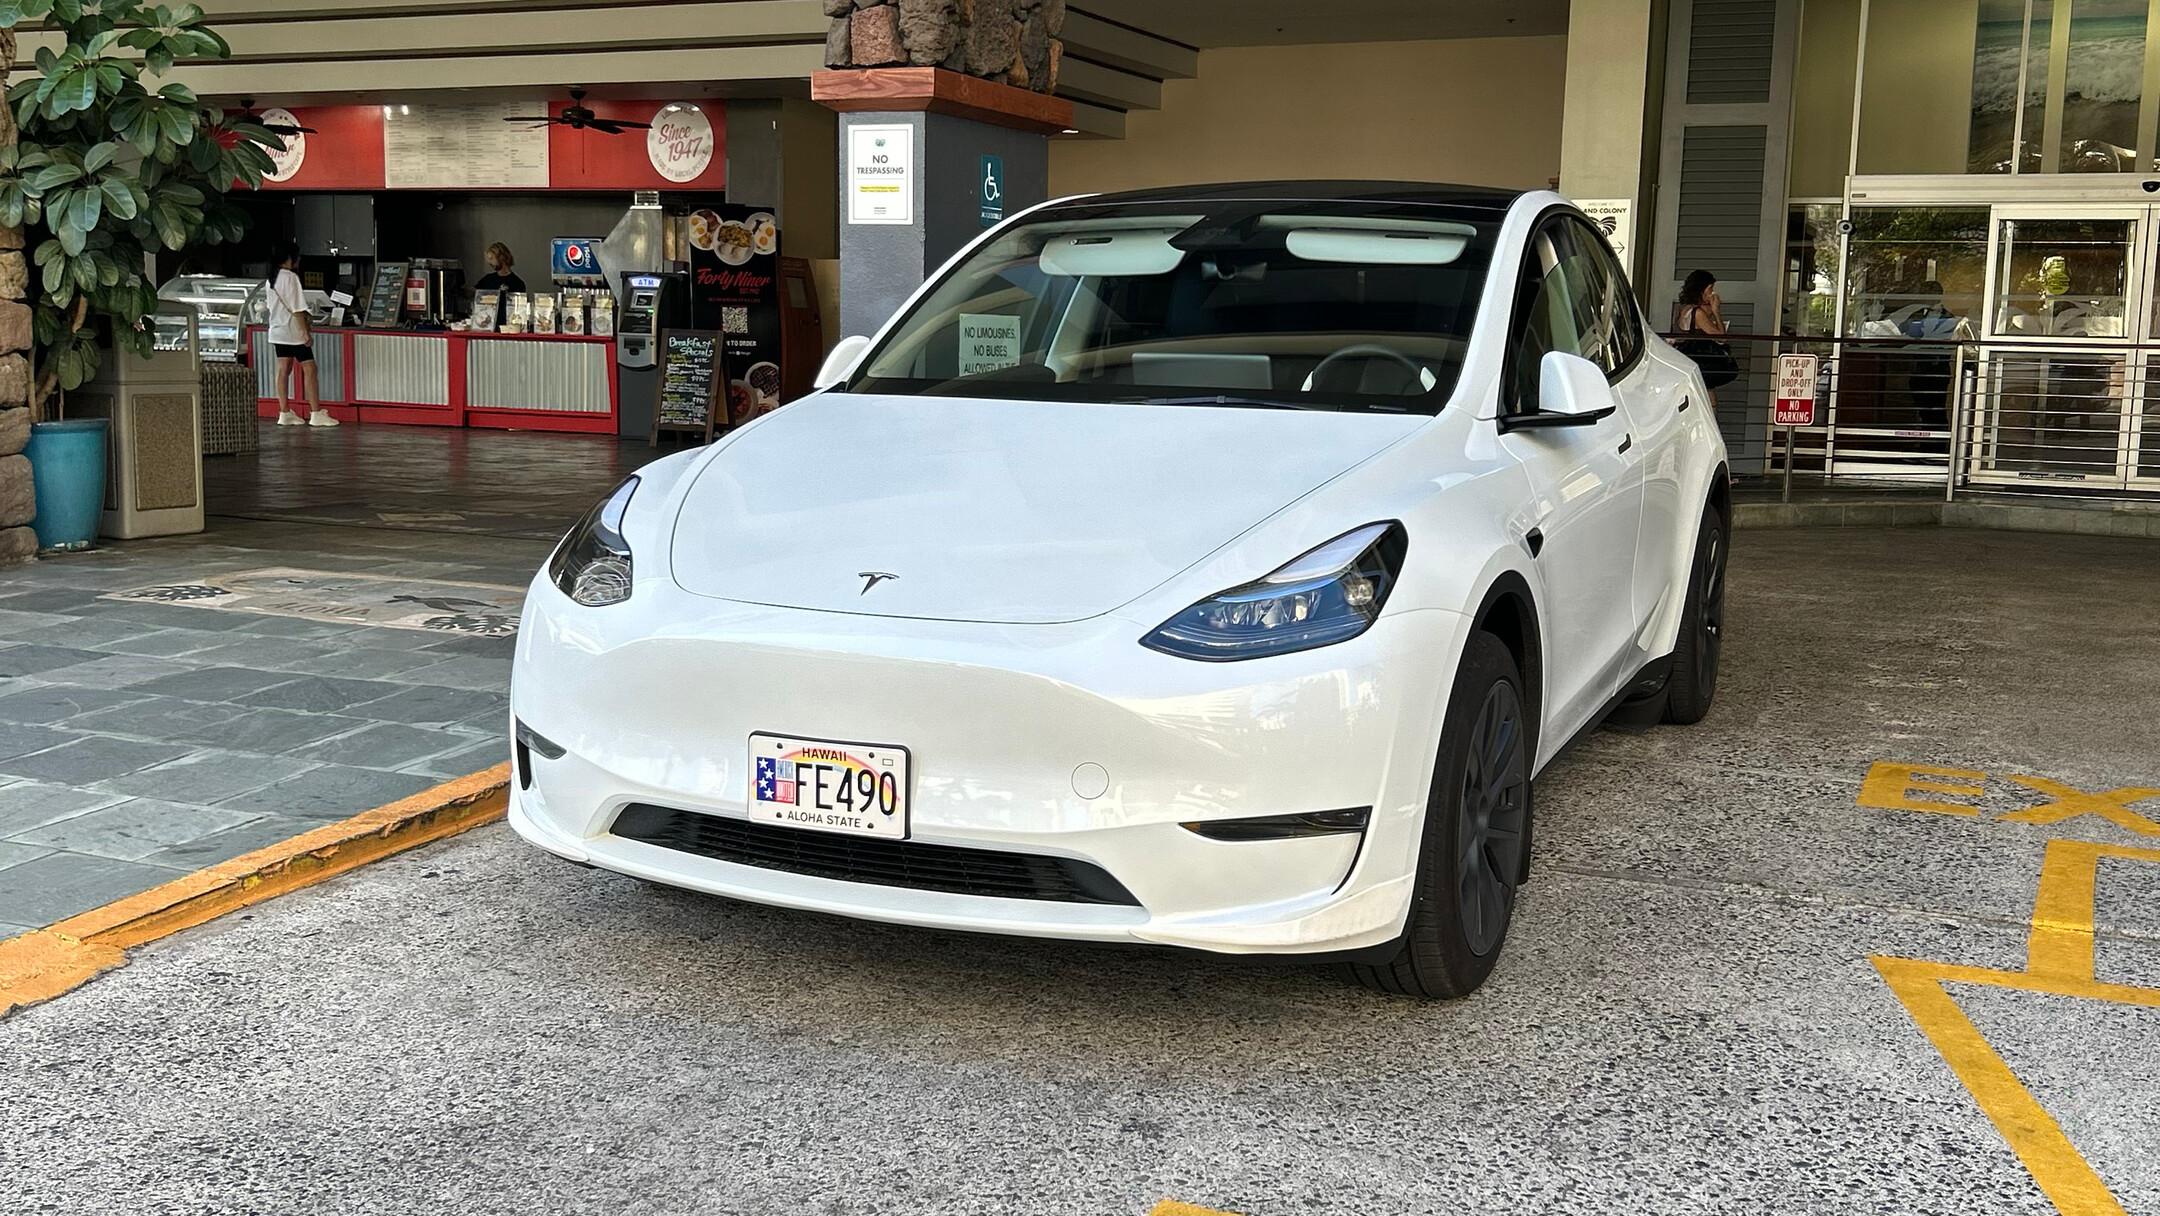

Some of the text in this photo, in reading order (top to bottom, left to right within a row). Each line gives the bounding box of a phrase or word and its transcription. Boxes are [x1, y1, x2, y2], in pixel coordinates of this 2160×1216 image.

[658, 123, 692, 145] Since
[668, 136, 704, 162] 1947
[872, 154, 889, 164] NO
[856, 166, 905, 175] TRESPASSING
[697, 267, 771, 291] Forty Niner
[964, 326, 976, 339] NO
[668, 336, 712, 350] Breakfast
[973, 344, 1008, 358] NO BUSES
[1785, 358, 1811, 368] PICK-UP
[1789, 368, 1804, 378] AND
[1781, 378, 1812, 388] DROP-OFF
[1787, 388, 1804, 398] ONLY
[1788, 399, 1800, 411] NO
[1777, 411, 1810, 423] PARKING
[802, 747, 847, 762] HAWAII
[795, 762, 897, 816] FE490
[787, 810, 862, 828] ALOHA STATE
